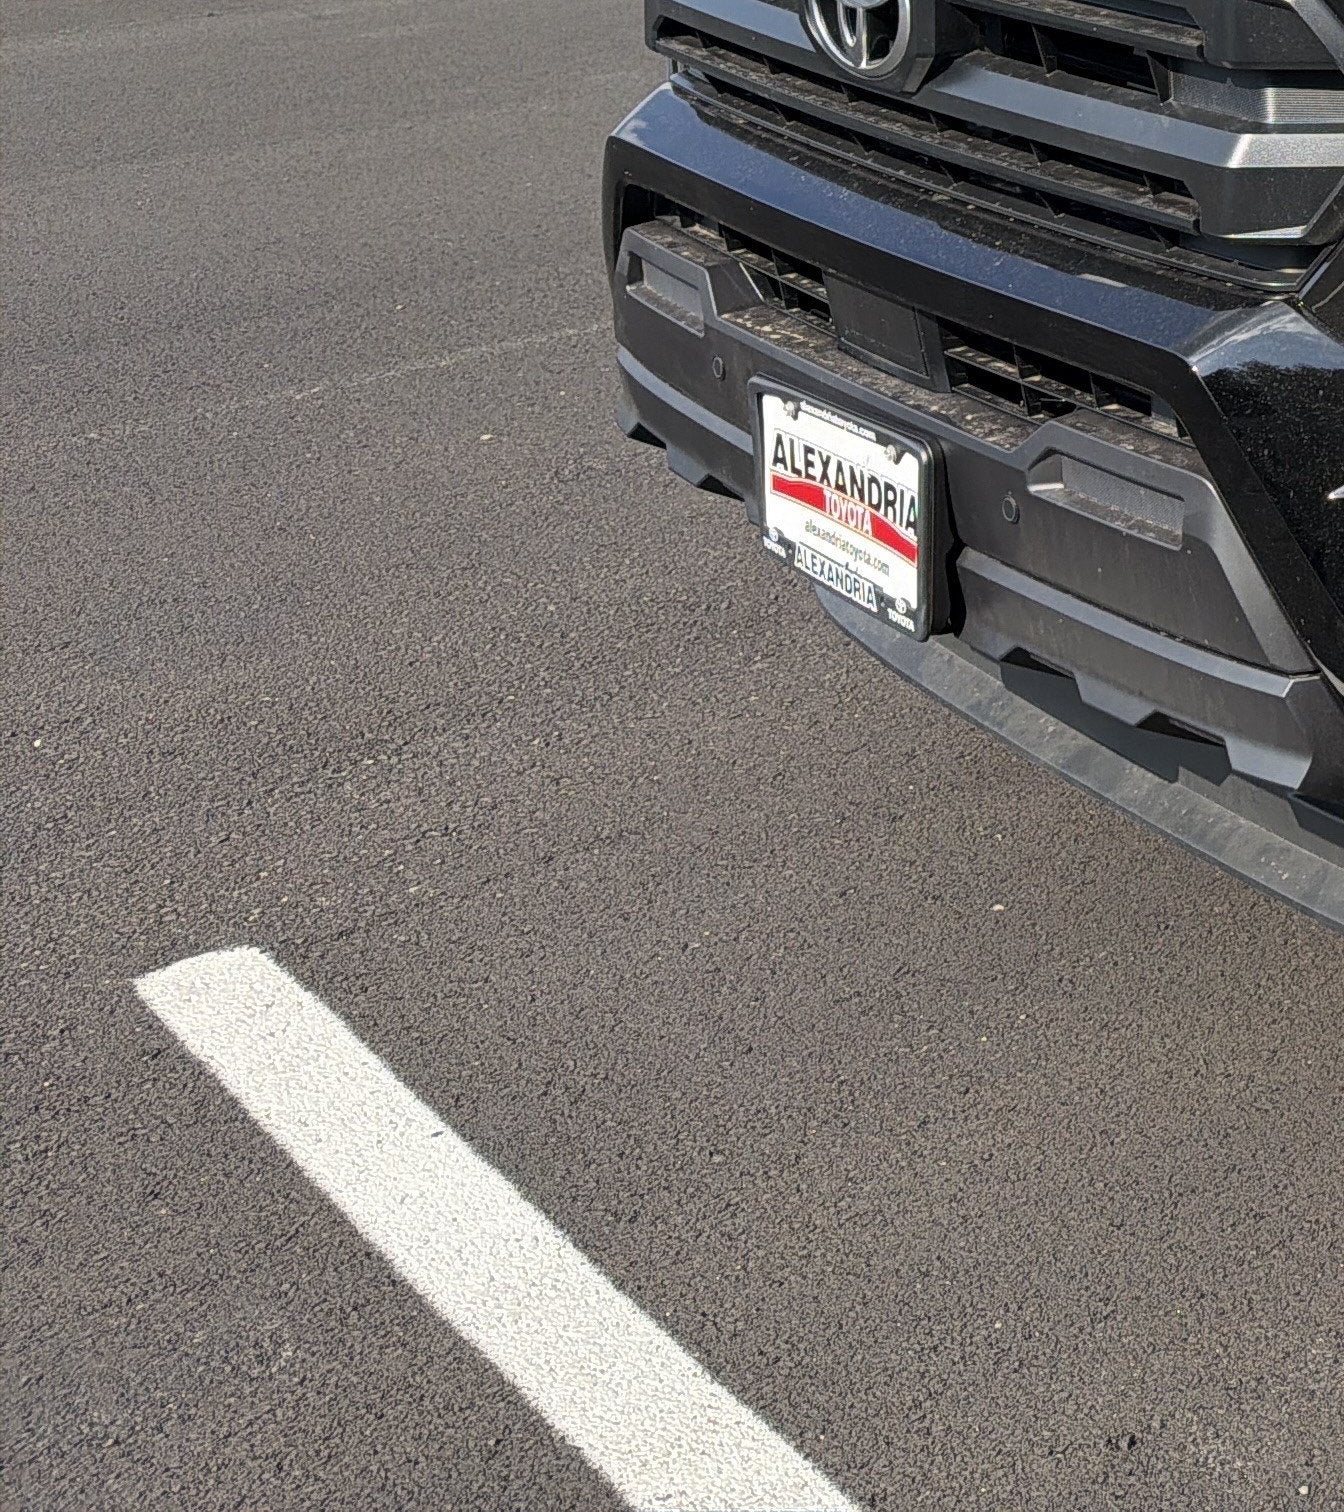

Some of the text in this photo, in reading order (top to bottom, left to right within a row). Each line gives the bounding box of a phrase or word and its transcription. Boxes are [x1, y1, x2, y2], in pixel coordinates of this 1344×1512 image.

[772, 431, 918, 534] ALEXANDRIA
[823, 490, 873, 537] TOYOTA
[804, 518, 890, 576] alexandriatoyota.com
[796, 543, 877, 611] ALEXANDRIA
[887, 608, 915, 632] TOYOTA
